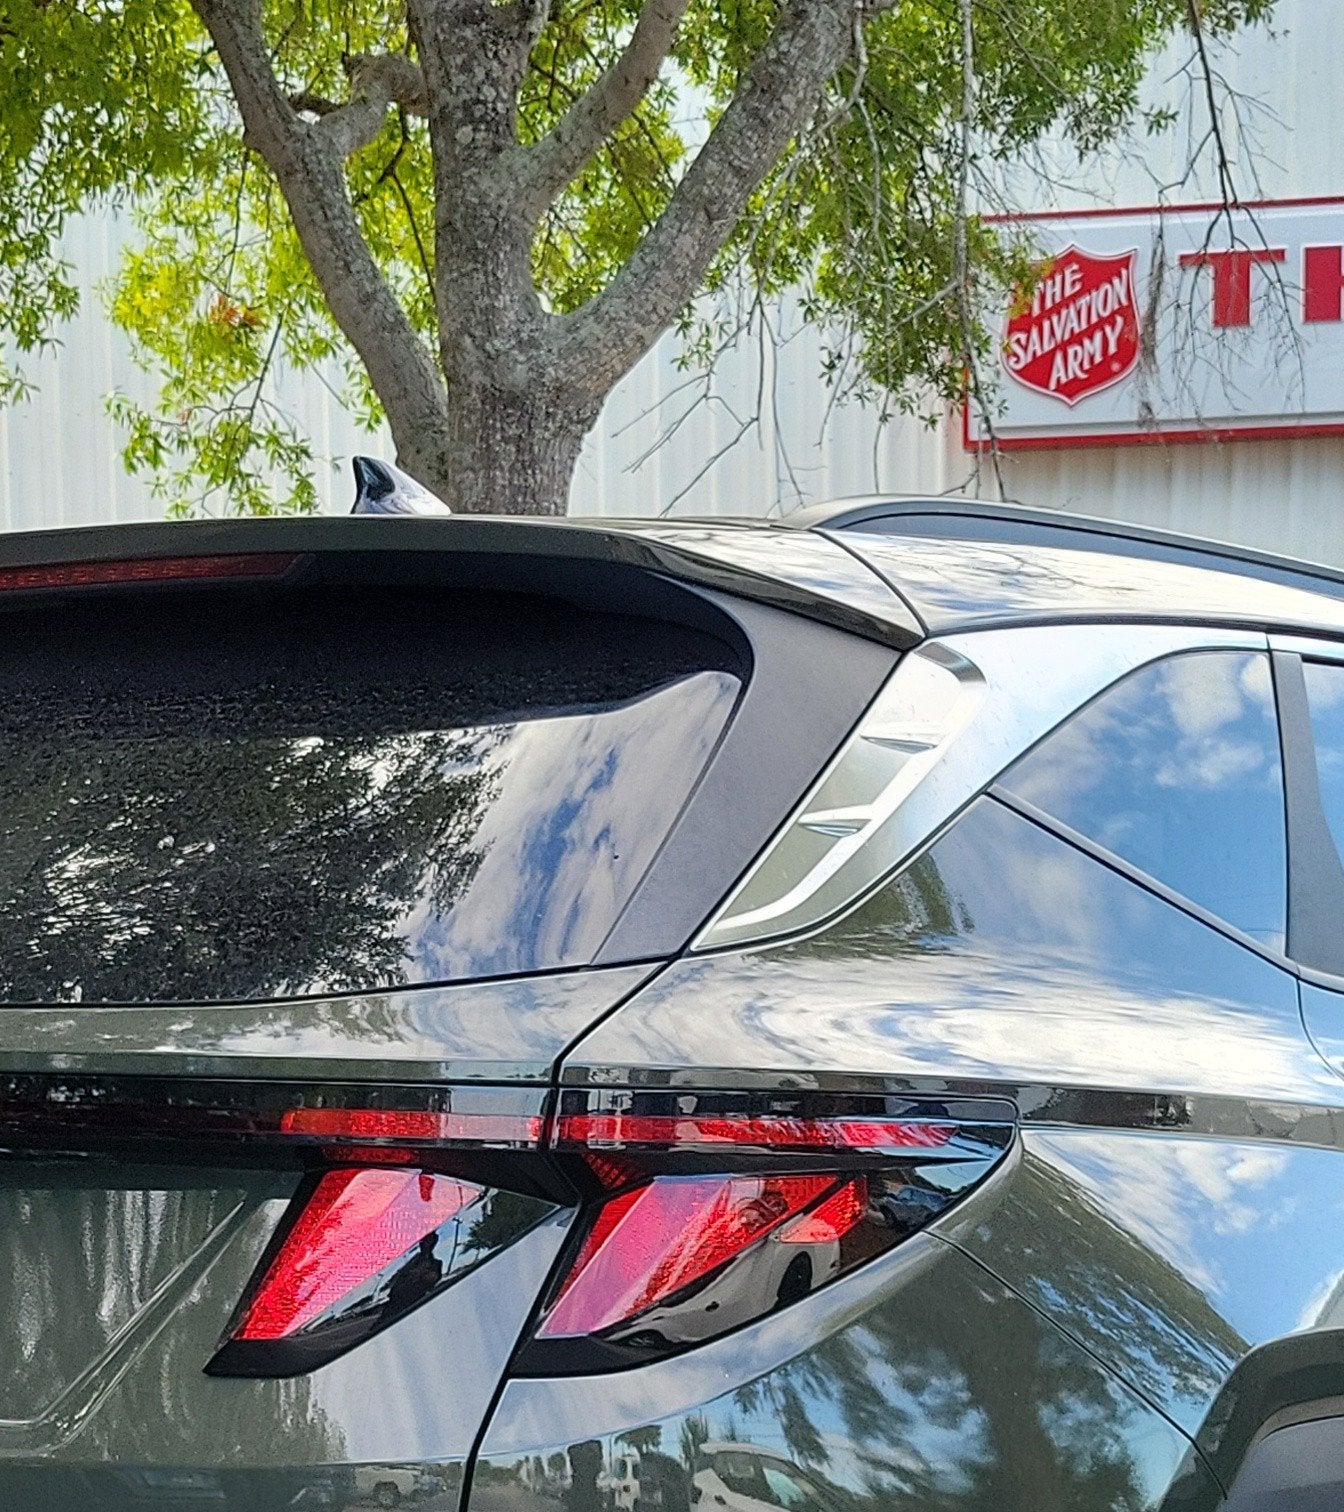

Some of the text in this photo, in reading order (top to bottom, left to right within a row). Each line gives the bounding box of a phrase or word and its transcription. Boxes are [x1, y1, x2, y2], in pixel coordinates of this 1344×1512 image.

[1008, 267, 1129, 371] SALVATION
[1032, 263, 1084, 317] THE
[1048, 315, 1124, 391] ARMY
